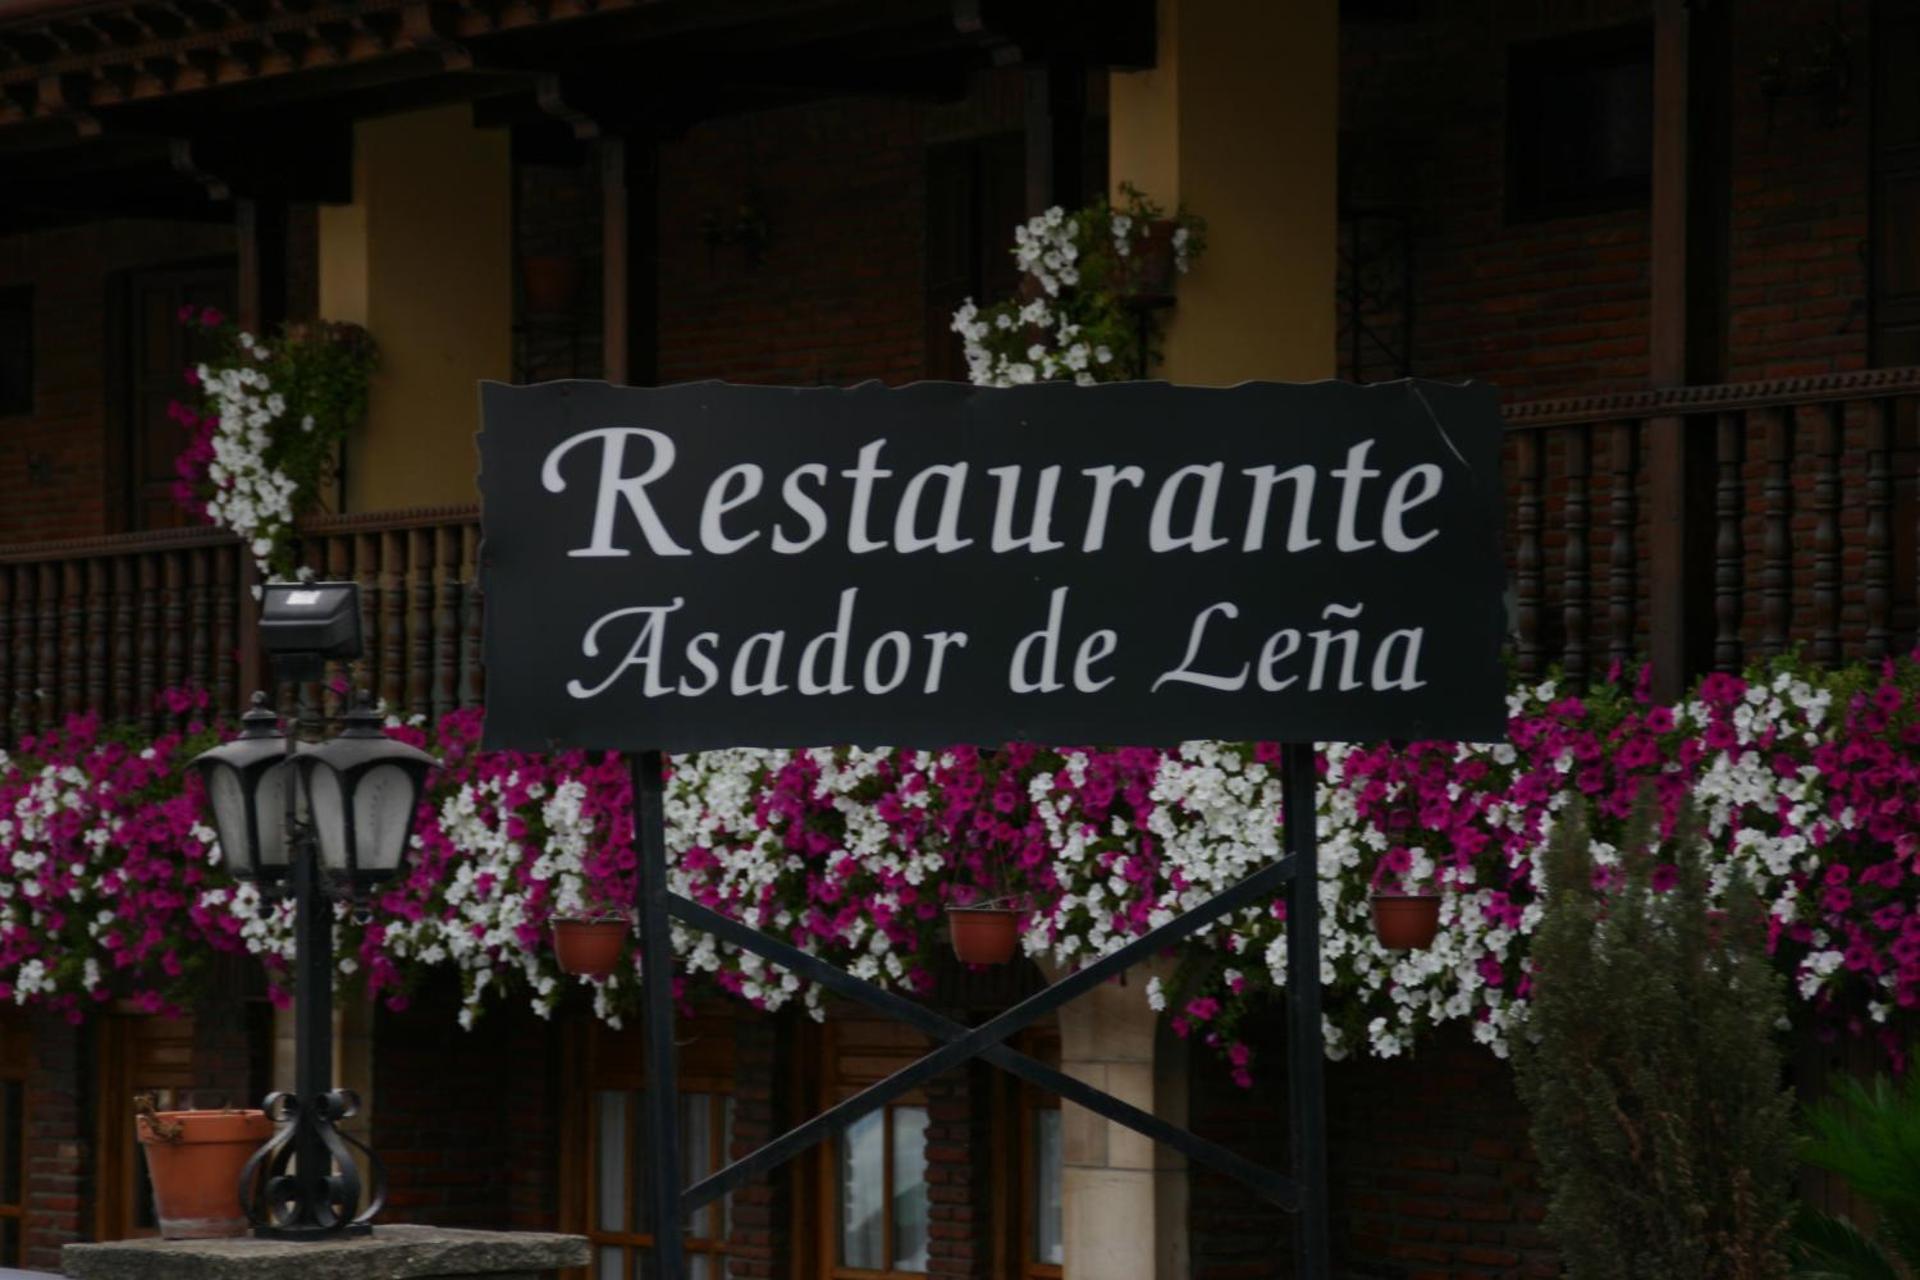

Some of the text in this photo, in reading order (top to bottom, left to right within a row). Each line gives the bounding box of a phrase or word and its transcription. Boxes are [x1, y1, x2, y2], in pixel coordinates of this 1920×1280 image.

[541, 427, 1443, 557] Restaurante
[567, 586, 1426, 699] Asador de Leña
